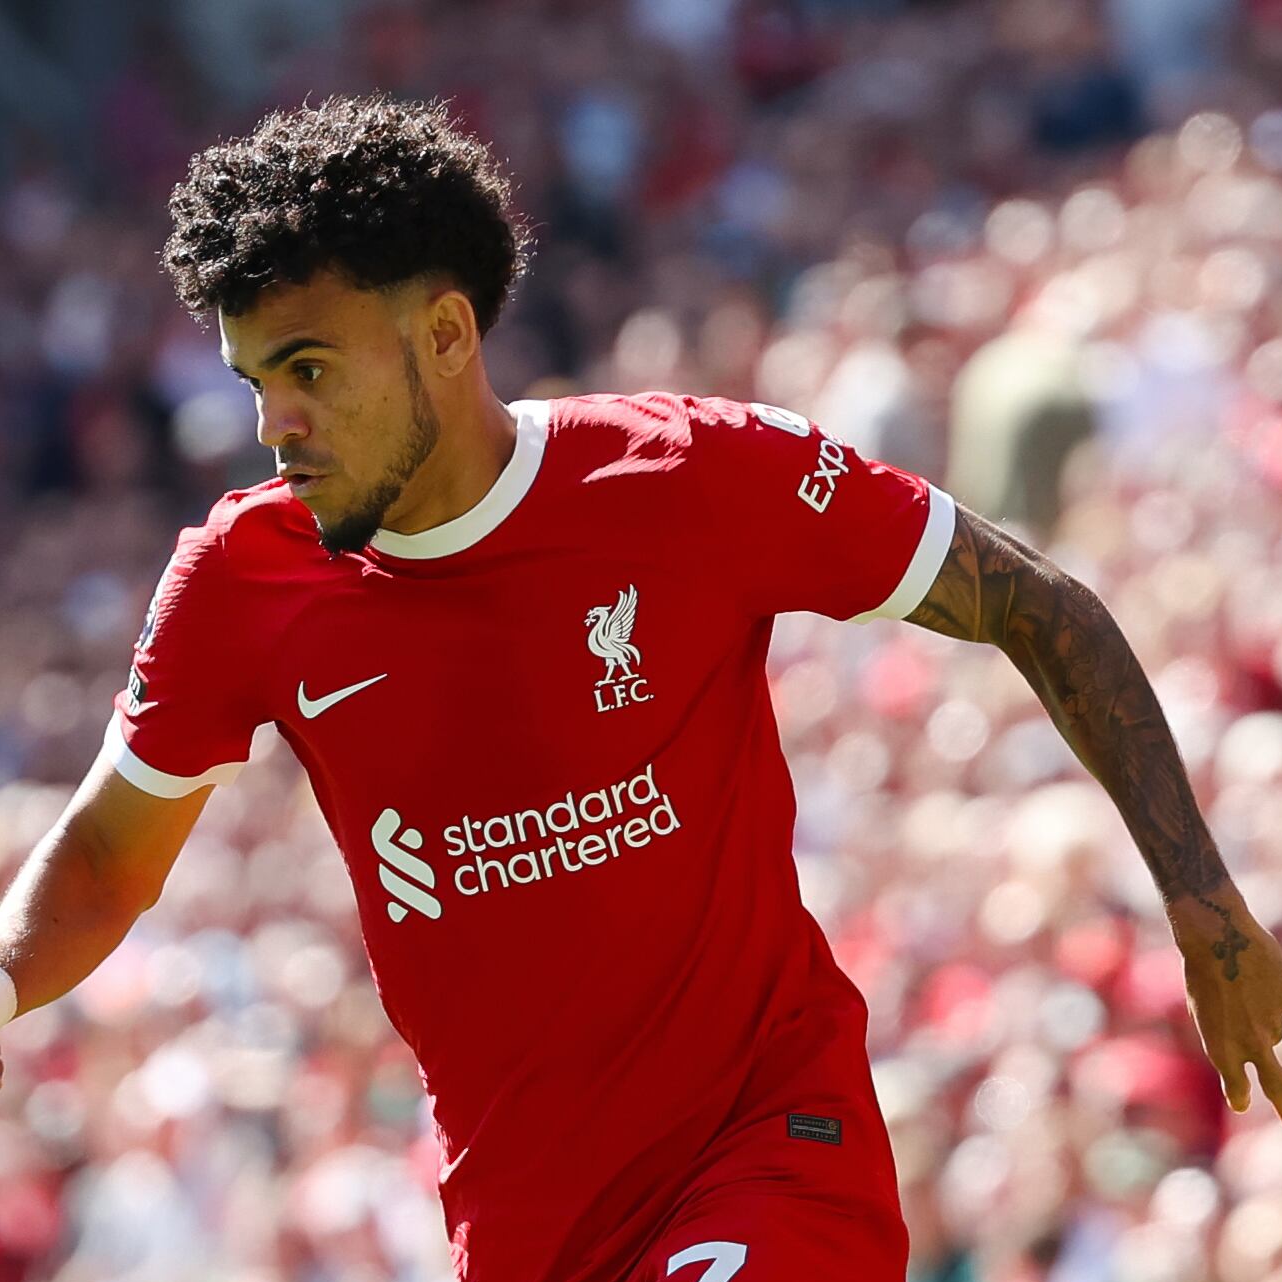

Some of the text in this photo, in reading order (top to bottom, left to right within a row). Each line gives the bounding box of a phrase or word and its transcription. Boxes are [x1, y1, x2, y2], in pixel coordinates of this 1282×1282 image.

[798, 433, 849, 513] Exp
[593, 679, 655, 713] L.F.C.
[443, 763, 660, 857] standard
[454, 794, 681, 895] chartered
